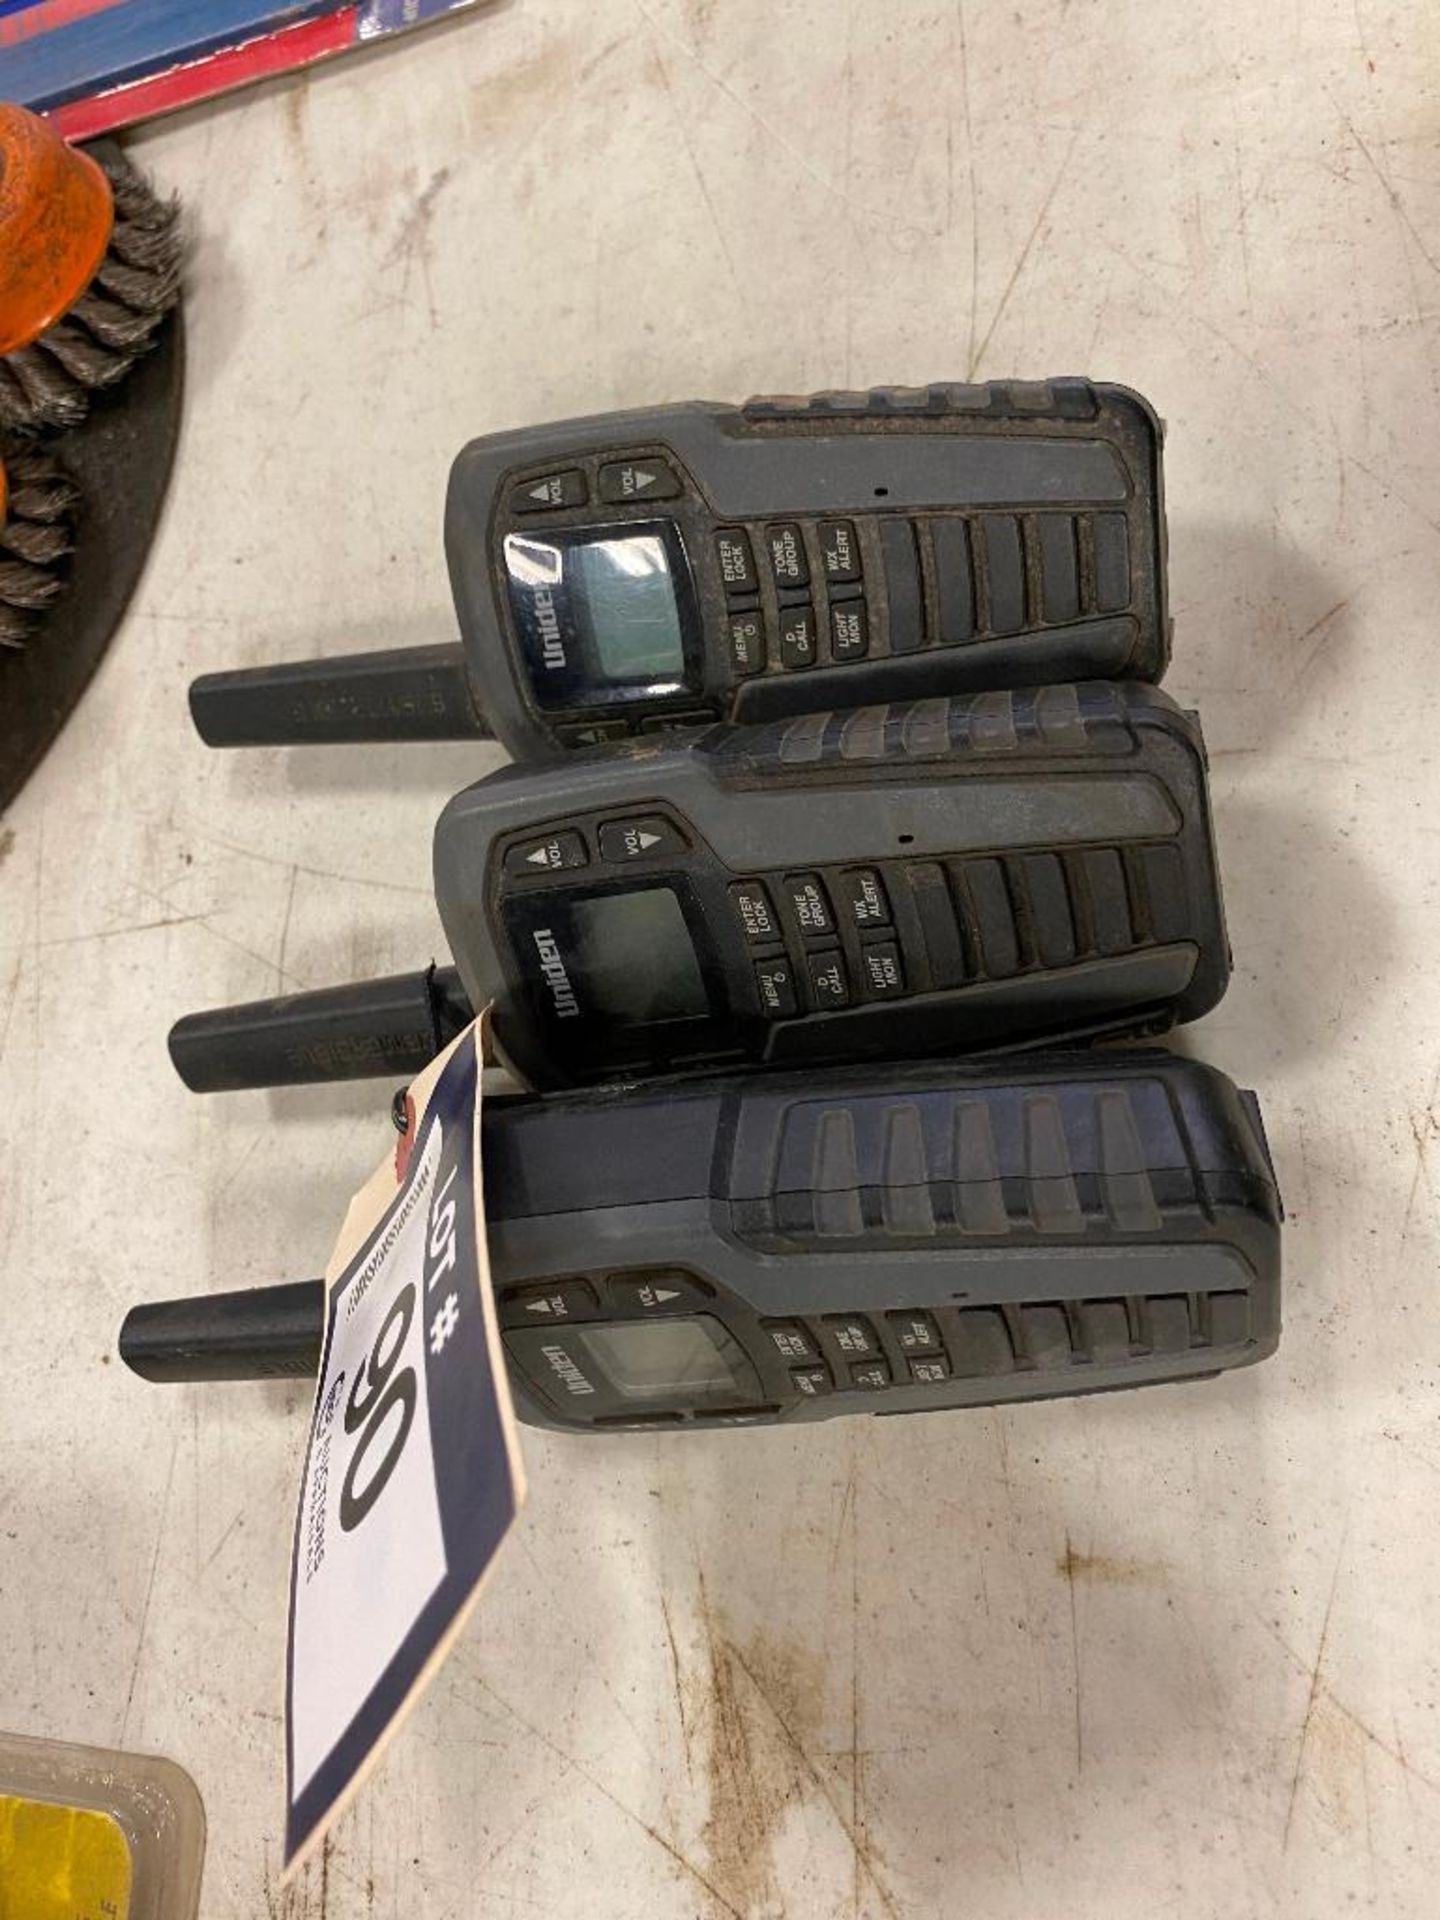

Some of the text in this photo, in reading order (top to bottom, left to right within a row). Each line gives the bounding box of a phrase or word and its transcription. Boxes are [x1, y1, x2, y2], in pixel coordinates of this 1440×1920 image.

[550, 478, 563, 504] VOL
[623, 468, 635, 494] VOL
[720, 540, 735, 581] ENTER
[732, 546, 746, 580] LOCK
[773, 540, 787, 574] TONE
[783, 531, 799, 576] GROUP
[827, 551, 838, 570] WX
[836, 530, 851, 570] ALERT
[733, 626, 748, 662] MENU
[795, 621, 808, 651] CALL
[835, 612, 850, 647] LIGHT
[848, 615, 861, 643] MON
[548, 840, 563, 869] VOL
[624, 829, 640, 855] VOL
[794, 894, 813, 926] TONE
[804, 885, 825, 926] GROUP
[853, 899, 869, 919] WX
[861, 879, 881, 917] ALERT
[739, 896, 759, 934] ENTER
[753, 901, 771, 932] LOCK
[533, 928, 579, 1018] Uniden
[827, 966, 844, 994] CALL
[868, 956, 887, 989] LIGHT
[882, 957, 899, 985] MON
[761, 975, 780, 1007] MENU
[428, 1164, 461, 1354] LOT #
[550, 1295, 568, 1316] VOL
[541, 1346, 595, 1395] Uniden
[339, 1282, 417, 1532] 90
